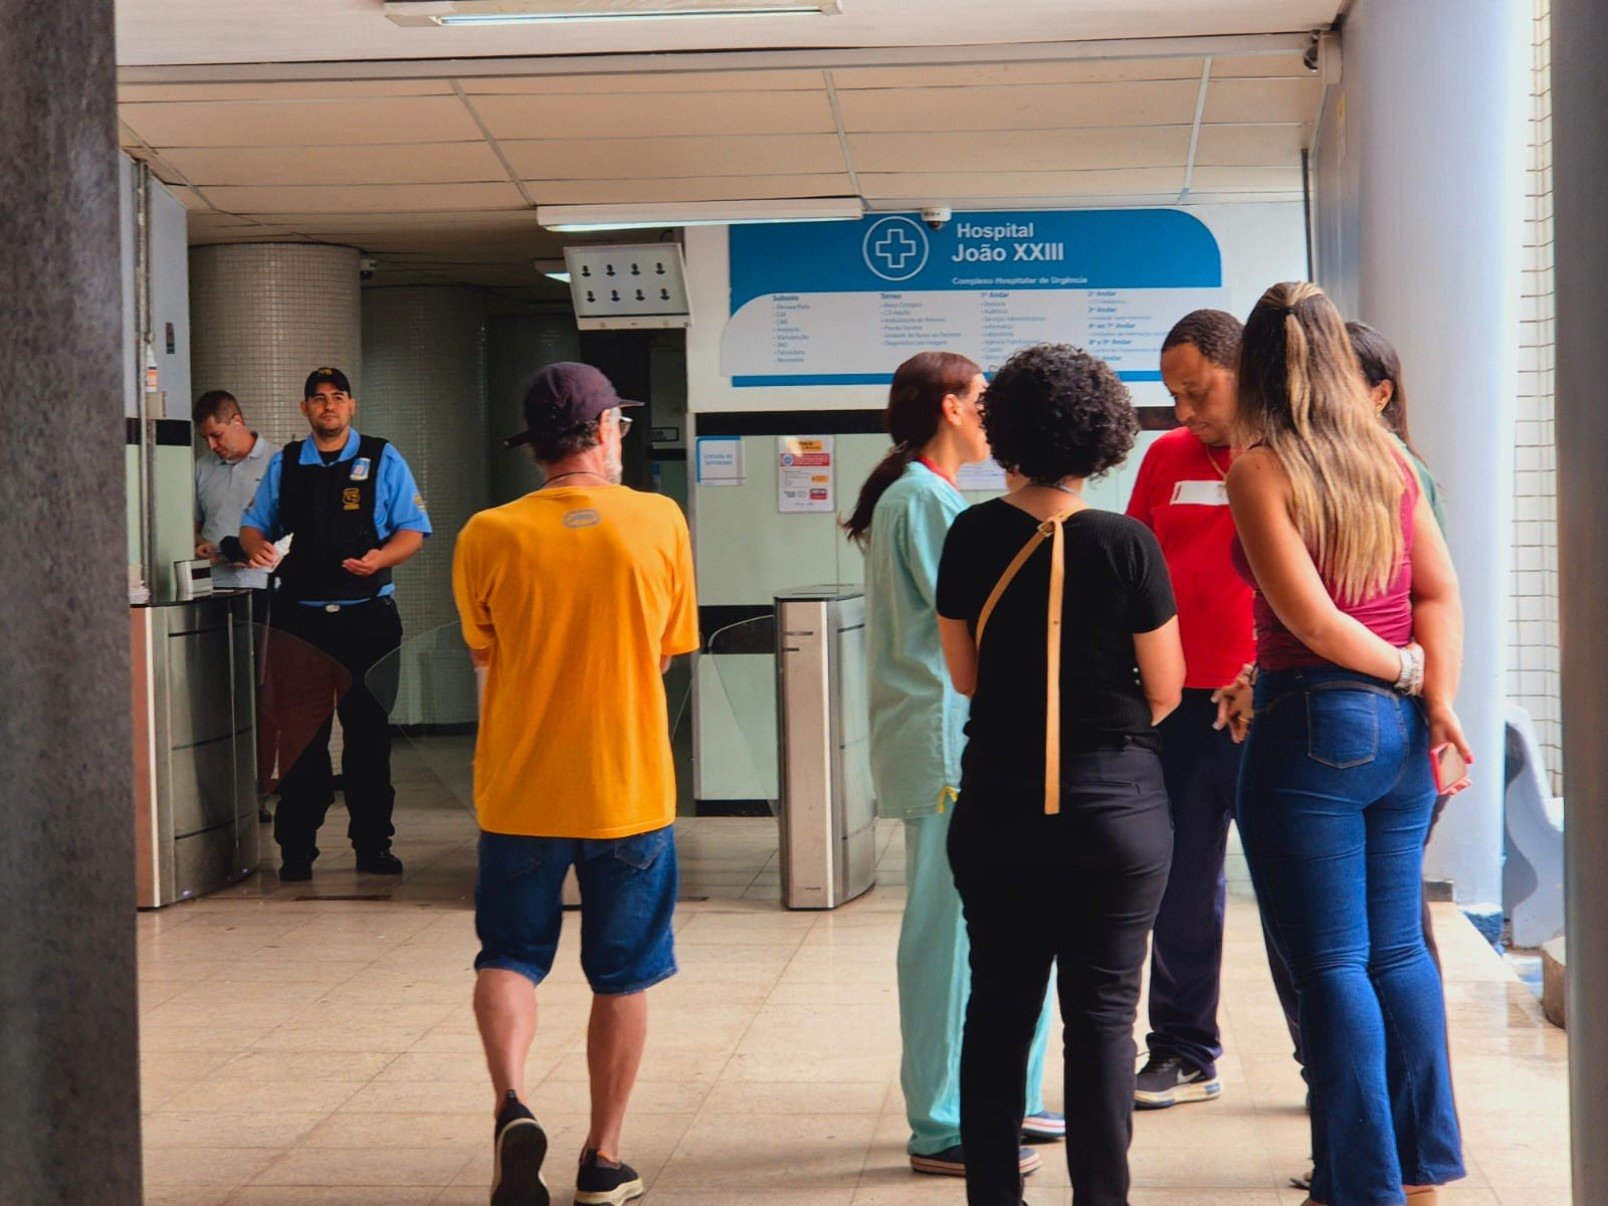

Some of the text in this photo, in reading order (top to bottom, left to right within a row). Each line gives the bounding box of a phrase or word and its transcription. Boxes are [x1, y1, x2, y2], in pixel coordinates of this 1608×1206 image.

[956, 223, 1034, 241] Hospital
[952, 242, 1064, 262] João XXIII
[952, 277, 994, 286] Complexo
[995, 277, 1037, 286] Hospitalar
[1051, 276, 1088, 286] Urgência
